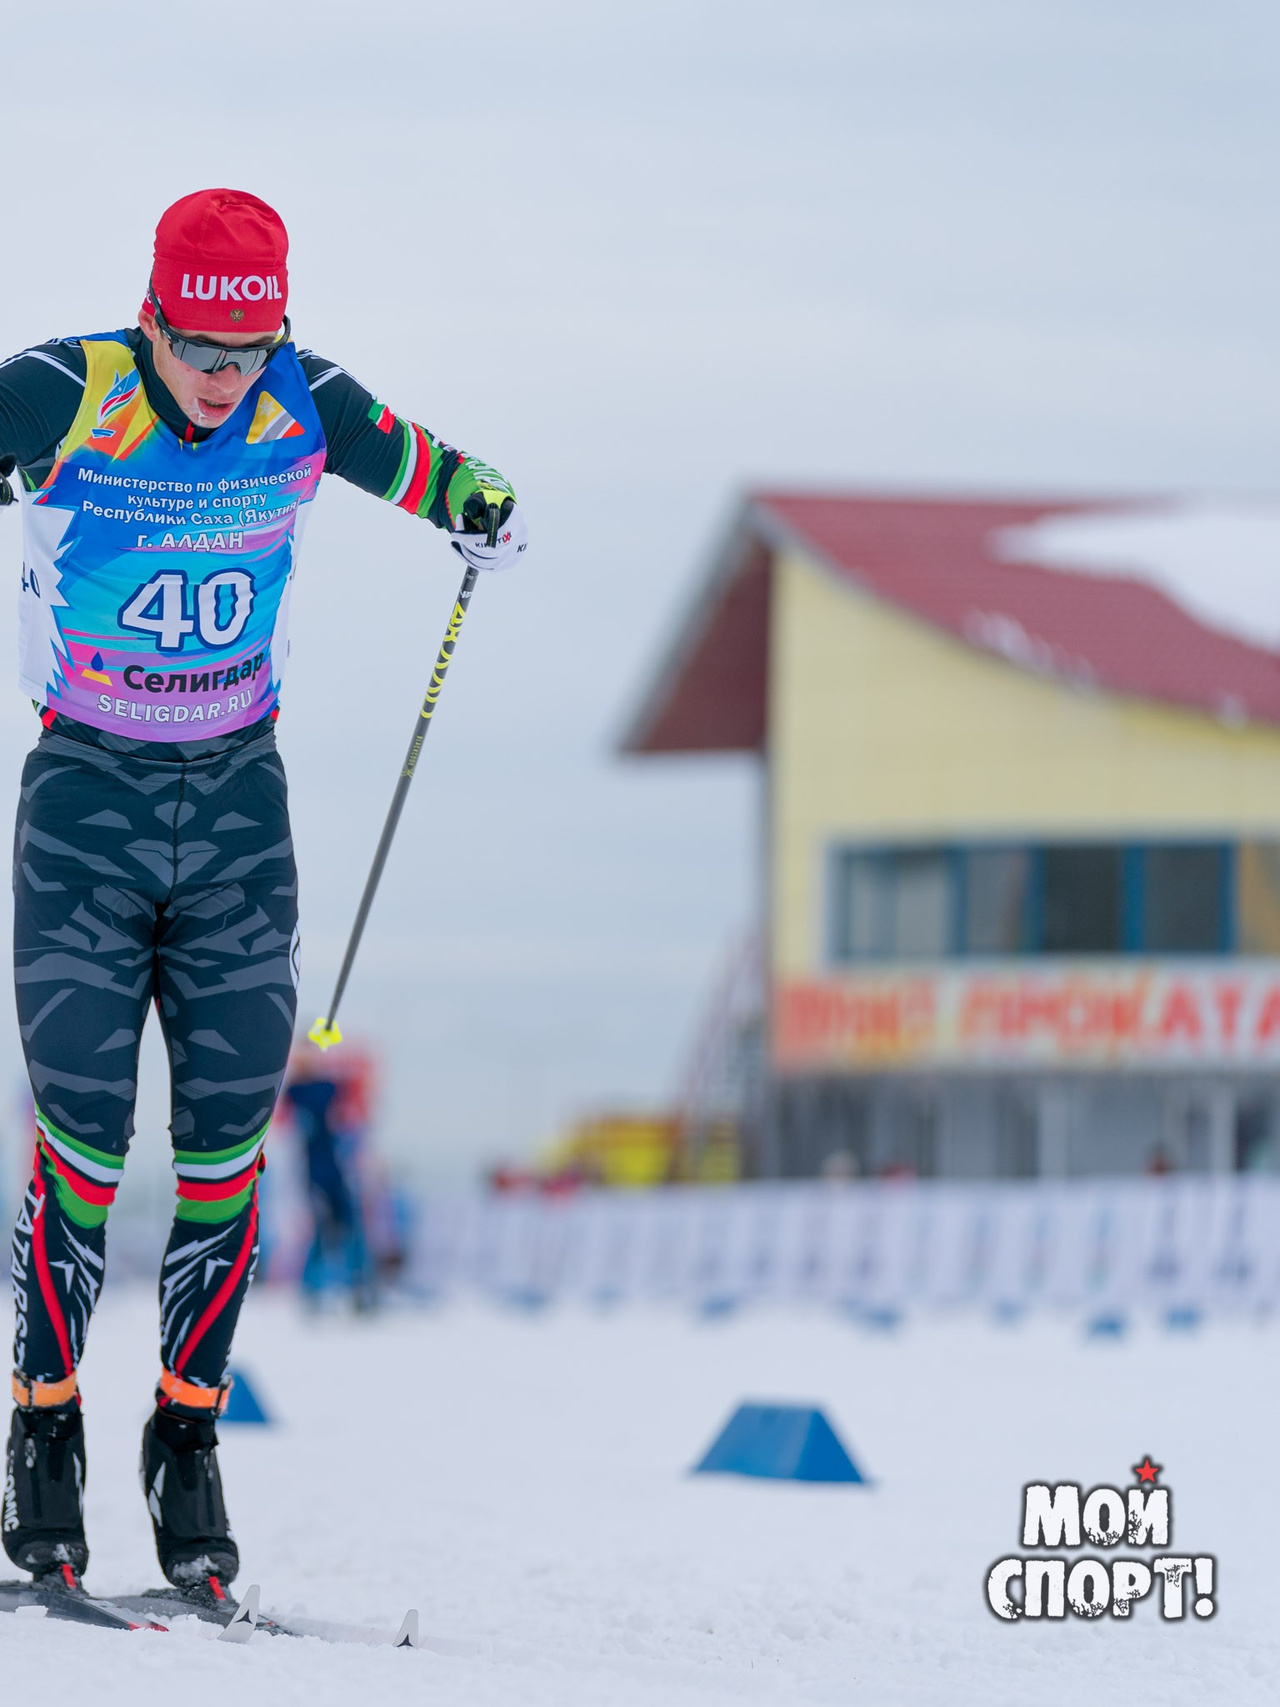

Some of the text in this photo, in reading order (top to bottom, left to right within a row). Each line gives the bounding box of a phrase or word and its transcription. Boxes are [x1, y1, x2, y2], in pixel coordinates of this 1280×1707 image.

[181, 274, 282, 301] LUKOIL
[77, 463, 312, 494] Министерство по физической
[82, 500, 187, 525] Республики
[190, 512, 234, 525] Саха
[127, 493, 267, 512] культуре и спорту
[137, 531, 244, 552] г. АЛДАН
[119, 569, 257, 650] 40
[123, 652, 264, 693] Селигдар
[97, 689, 253, 723] SELIGDAR.RU
